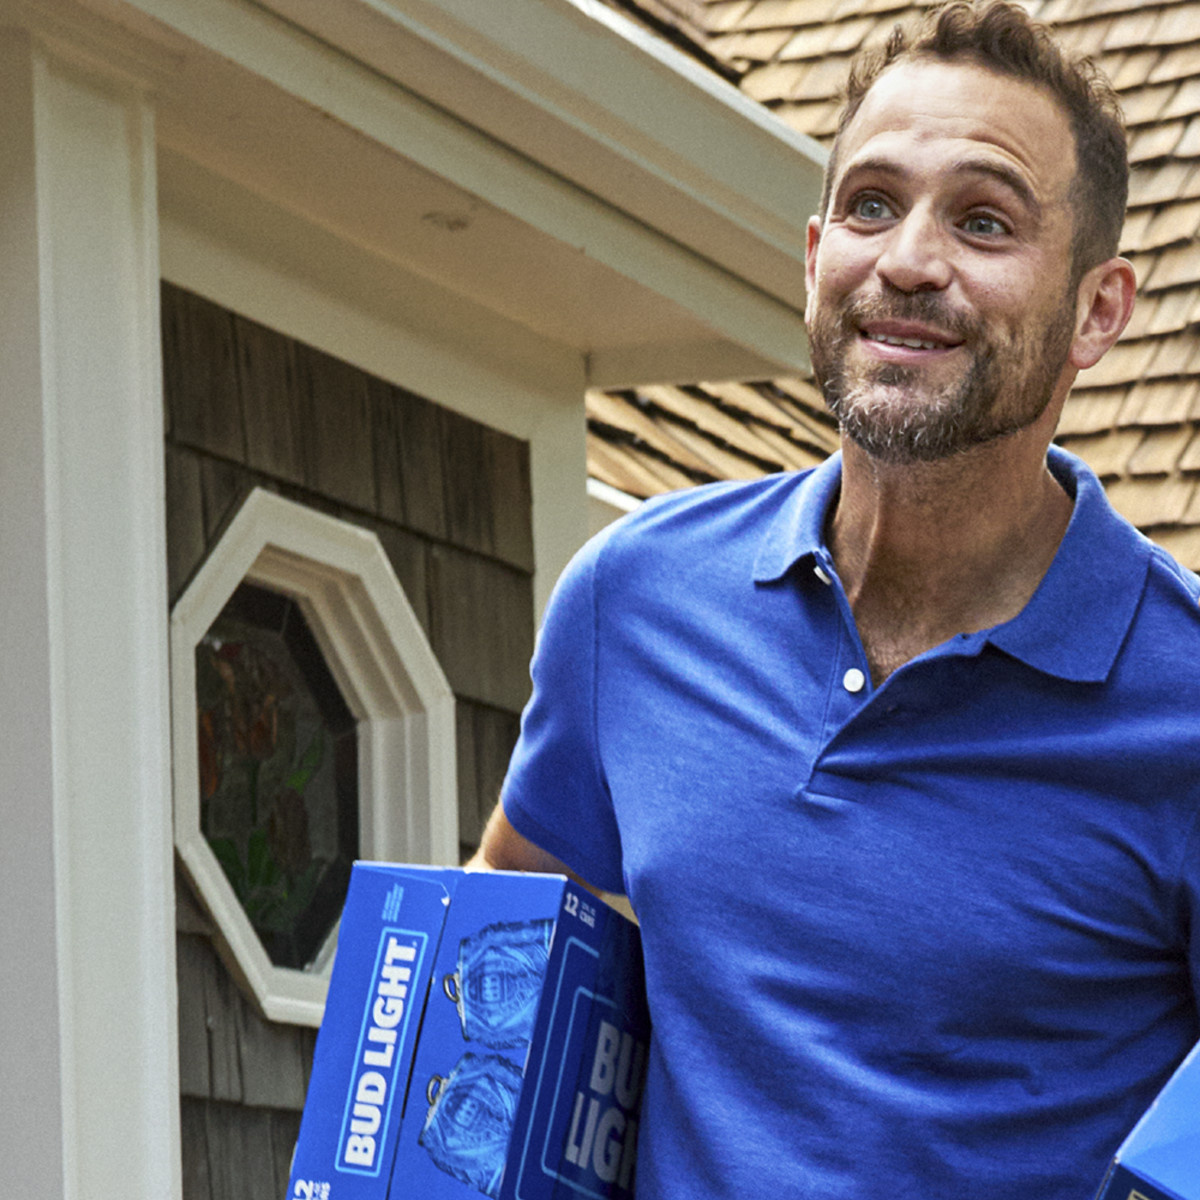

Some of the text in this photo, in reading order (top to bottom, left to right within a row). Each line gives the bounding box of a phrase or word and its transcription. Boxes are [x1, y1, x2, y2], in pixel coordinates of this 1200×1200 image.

[562, 892, 577, 916] 12
[364, 938, 416, 1067] LIGHT
[589, 1020, 645, 1110] BU
[345, 1072, 387, 1166] BUD
